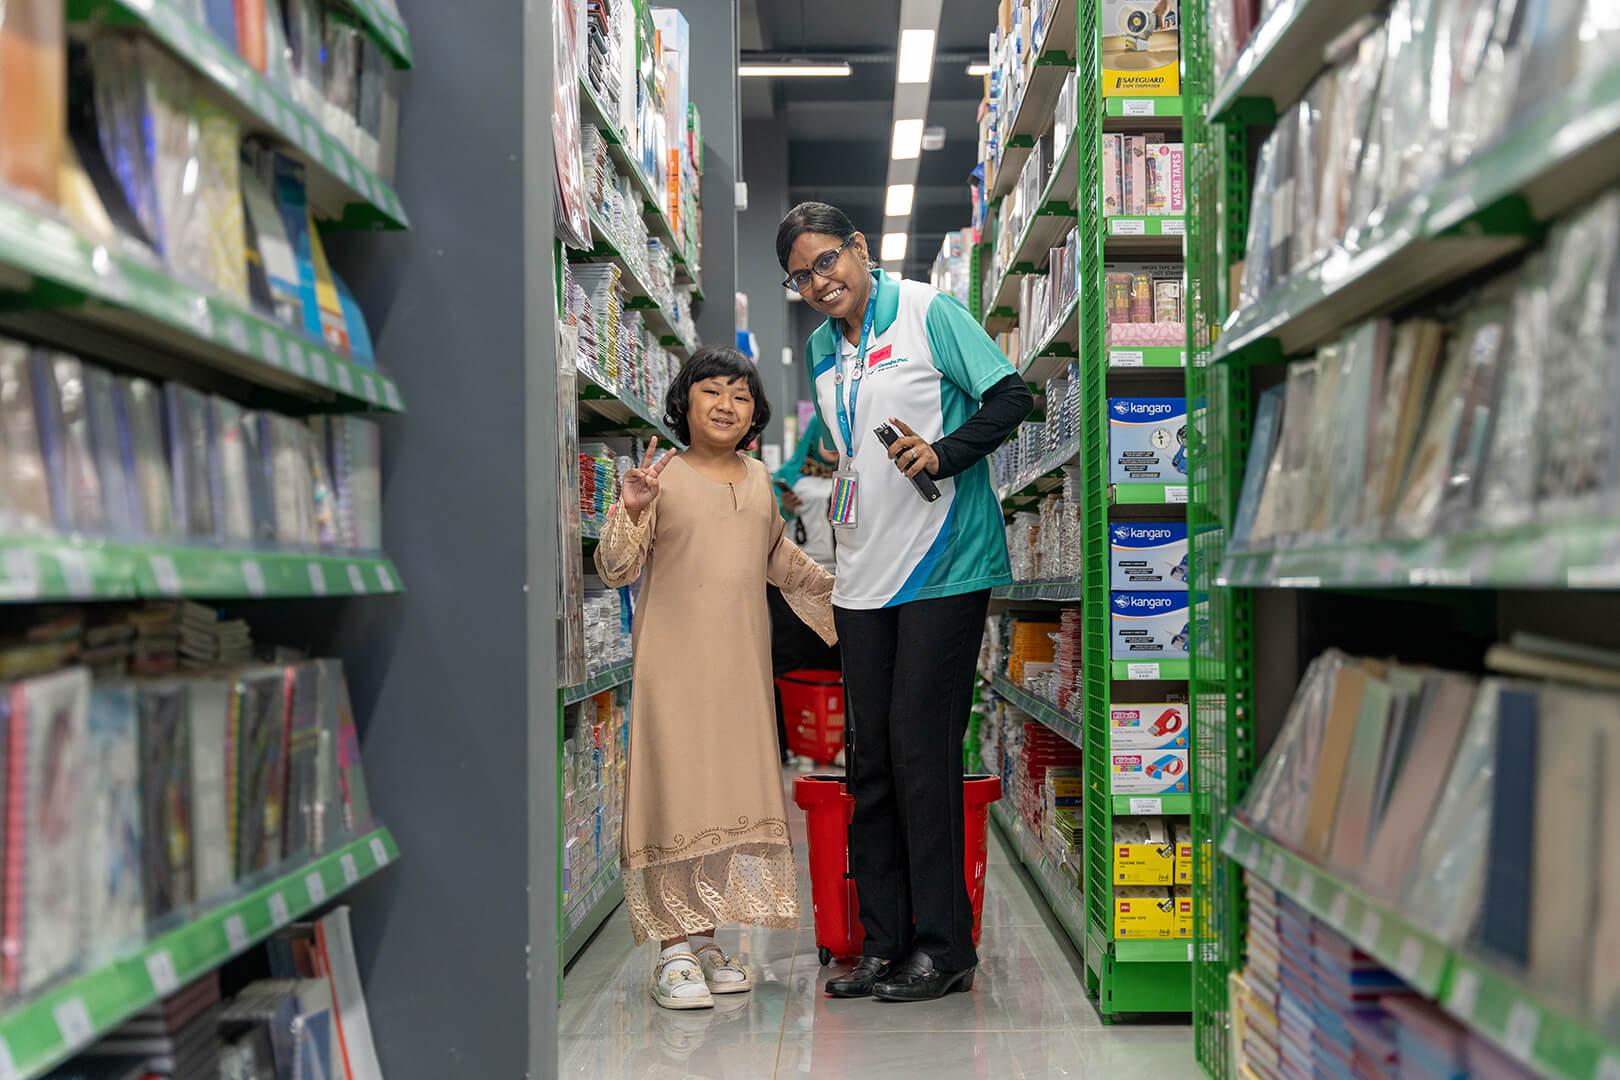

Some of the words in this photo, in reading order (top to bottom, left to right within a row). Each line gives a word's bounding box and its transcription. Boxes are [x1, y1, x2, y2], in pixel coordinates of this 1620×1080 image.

[1172, 153, 1181, 178] TAPES
[1172, 180, 1181, 206] WASHI
[1130, 402, 1172, 416] kangaro
[1130, 528, 1171, 540] kangaro
[1130, 596, 1172, 609] kangaro
